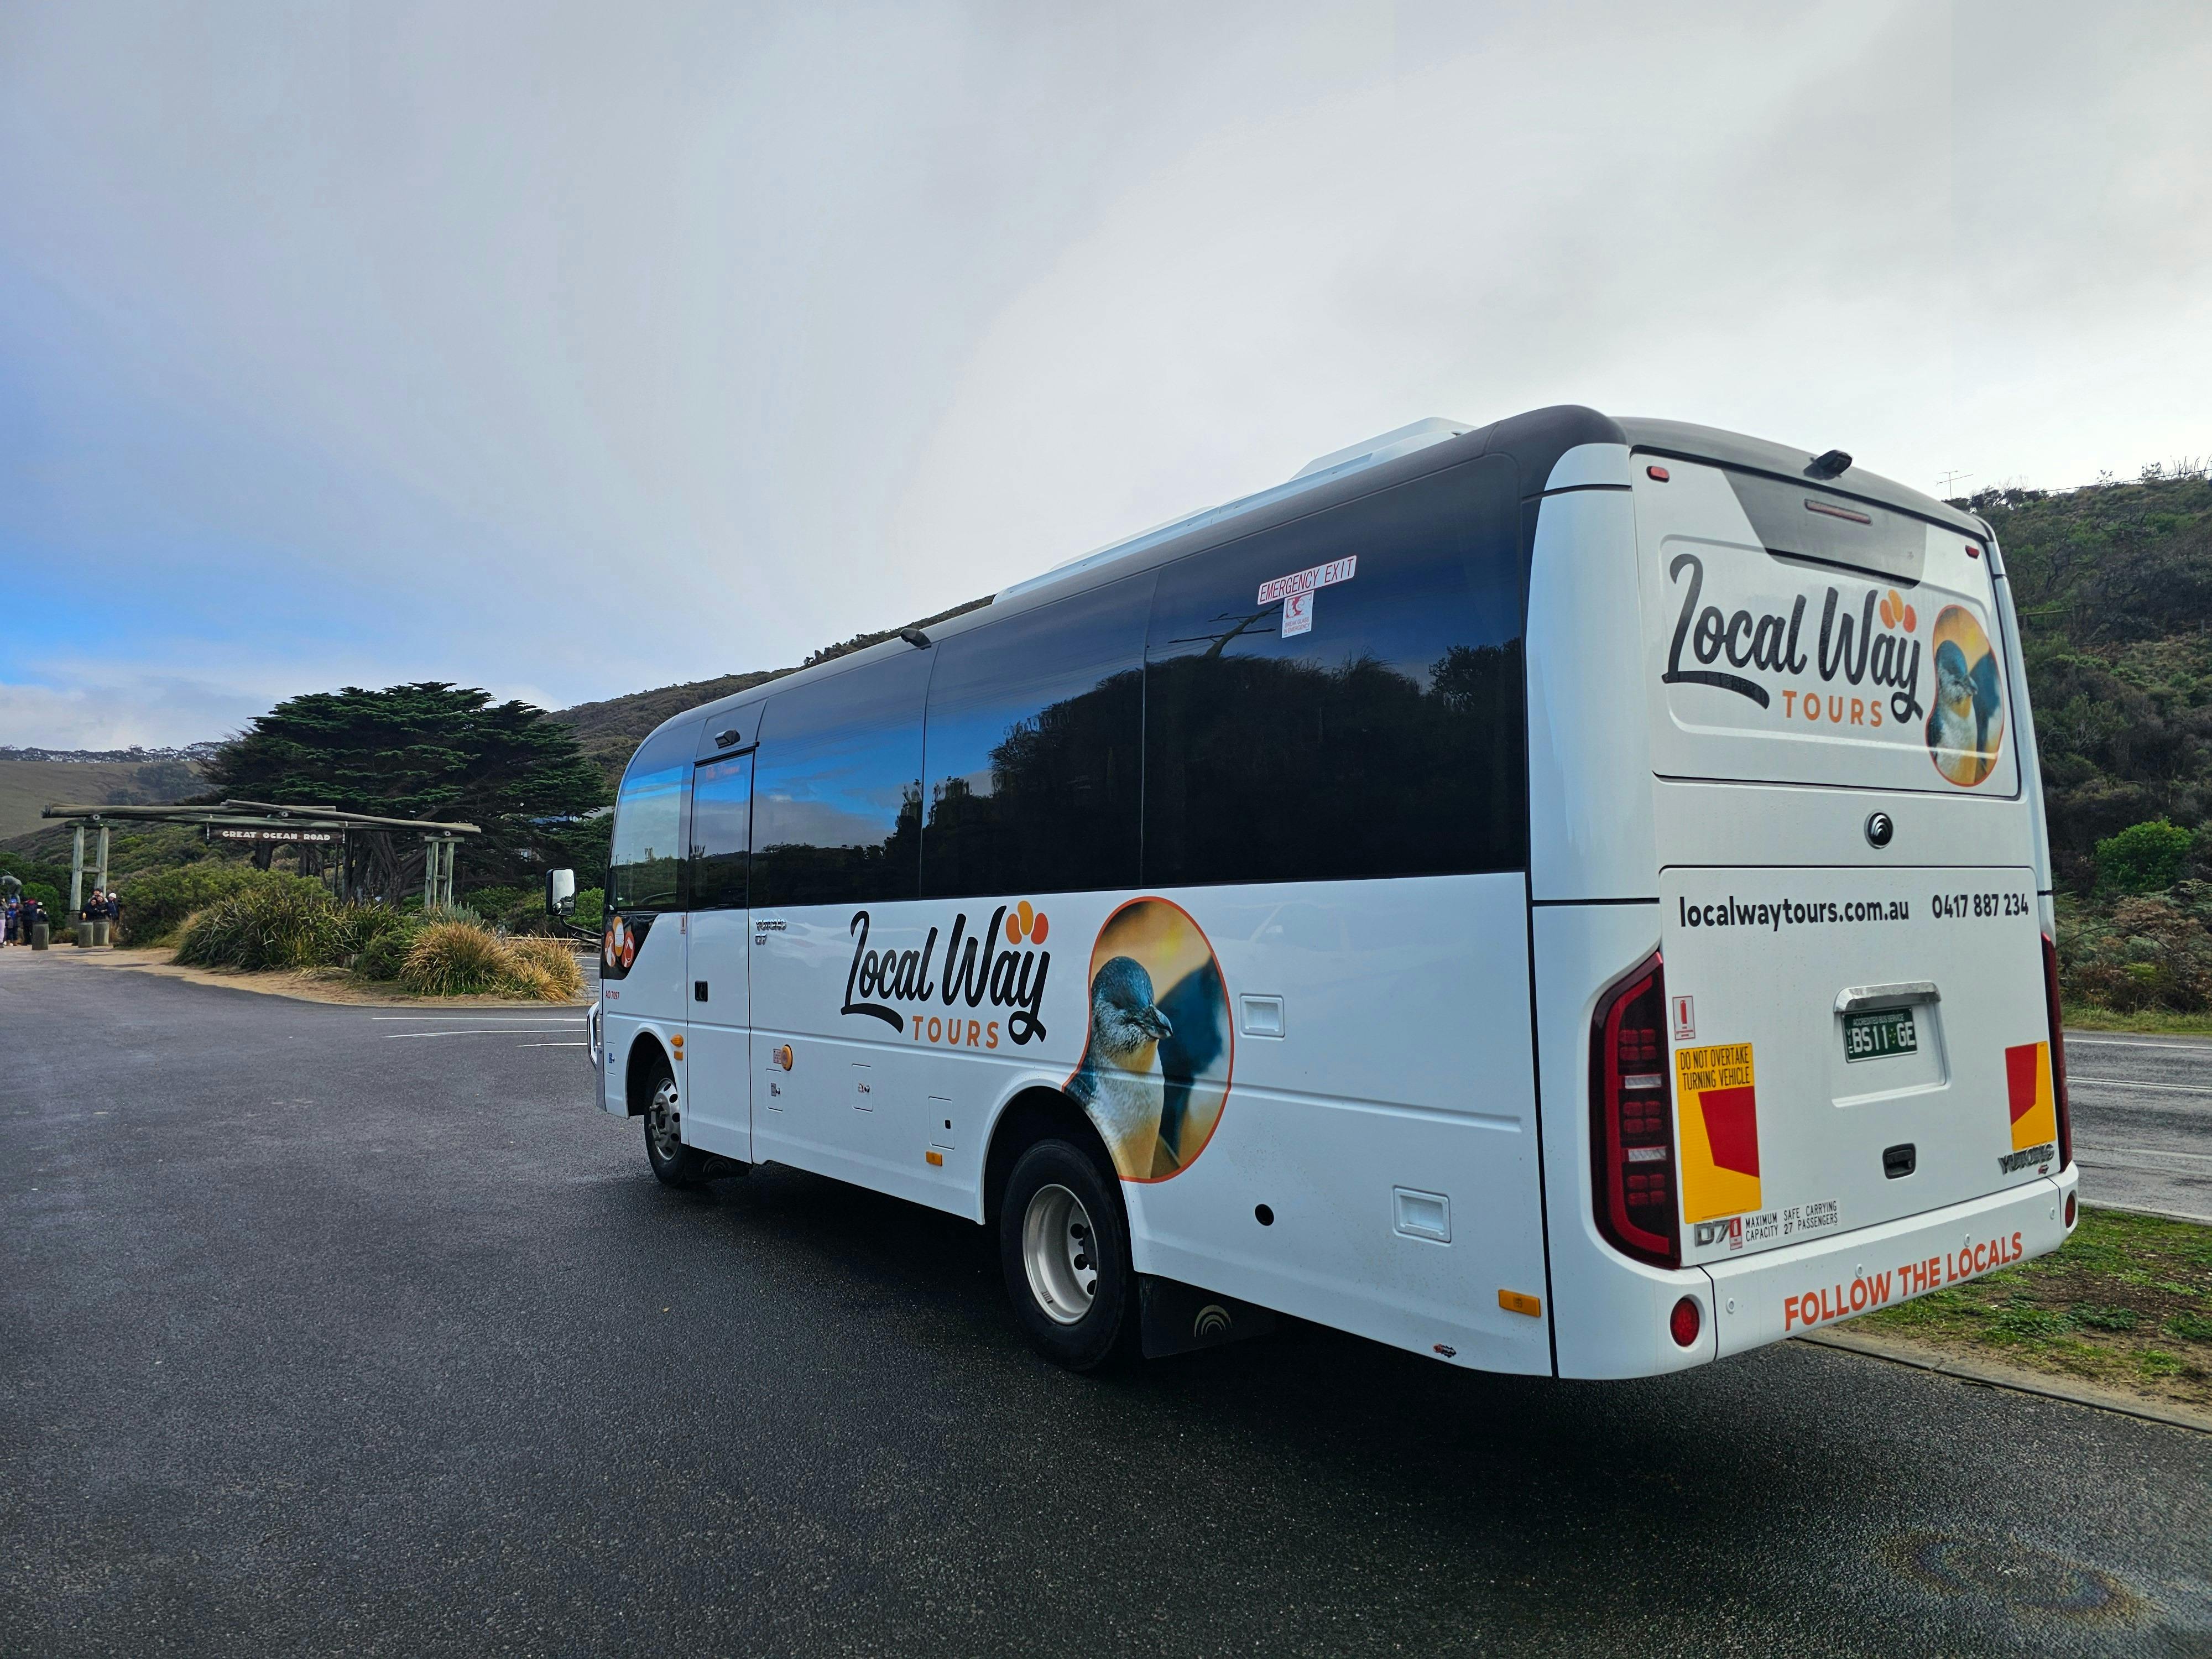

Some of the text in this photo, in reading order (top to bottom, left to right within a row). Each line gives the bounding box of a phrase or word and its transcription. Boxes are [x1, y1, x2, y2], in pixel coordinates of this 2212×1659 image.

[1260, 559, 1354, 602] EMERGENCY EXIT
[1661, 554, 1923, 724] Local Way
[1782, 690, 1882, 727] TOURS
[1679, 896, 1909, 931] localwaytours.com.au
[1932, 893, 2028, 919] 0417 887 234
[841, 905, 1050, 1045] Local Way
[912, 1015, 999, 1048] TOURS
[1851, 1021, 1916, 1053] BS11 GE
[1680, 1046, 1749, 1070] DO NOT OVERTAKE
[1682, 1067, 1750, 1091] TURNING VEHICLE
[1998, 1144, 2055, 1175] YUTONG
[1745, 1212, 1777, 1229] MAXIMUM
[1784, 1207, 1800, 1221] SAFE
[1806, 1201, 1837, 1217] CARRYING
[1746, 1212, 1838, 1242] CAPACITY 27 PASSENGERS
[1694, 1219, 1730, 1247] D7
[1785, 1232, 2023, 1332] FOLLOW THE LOCALS
